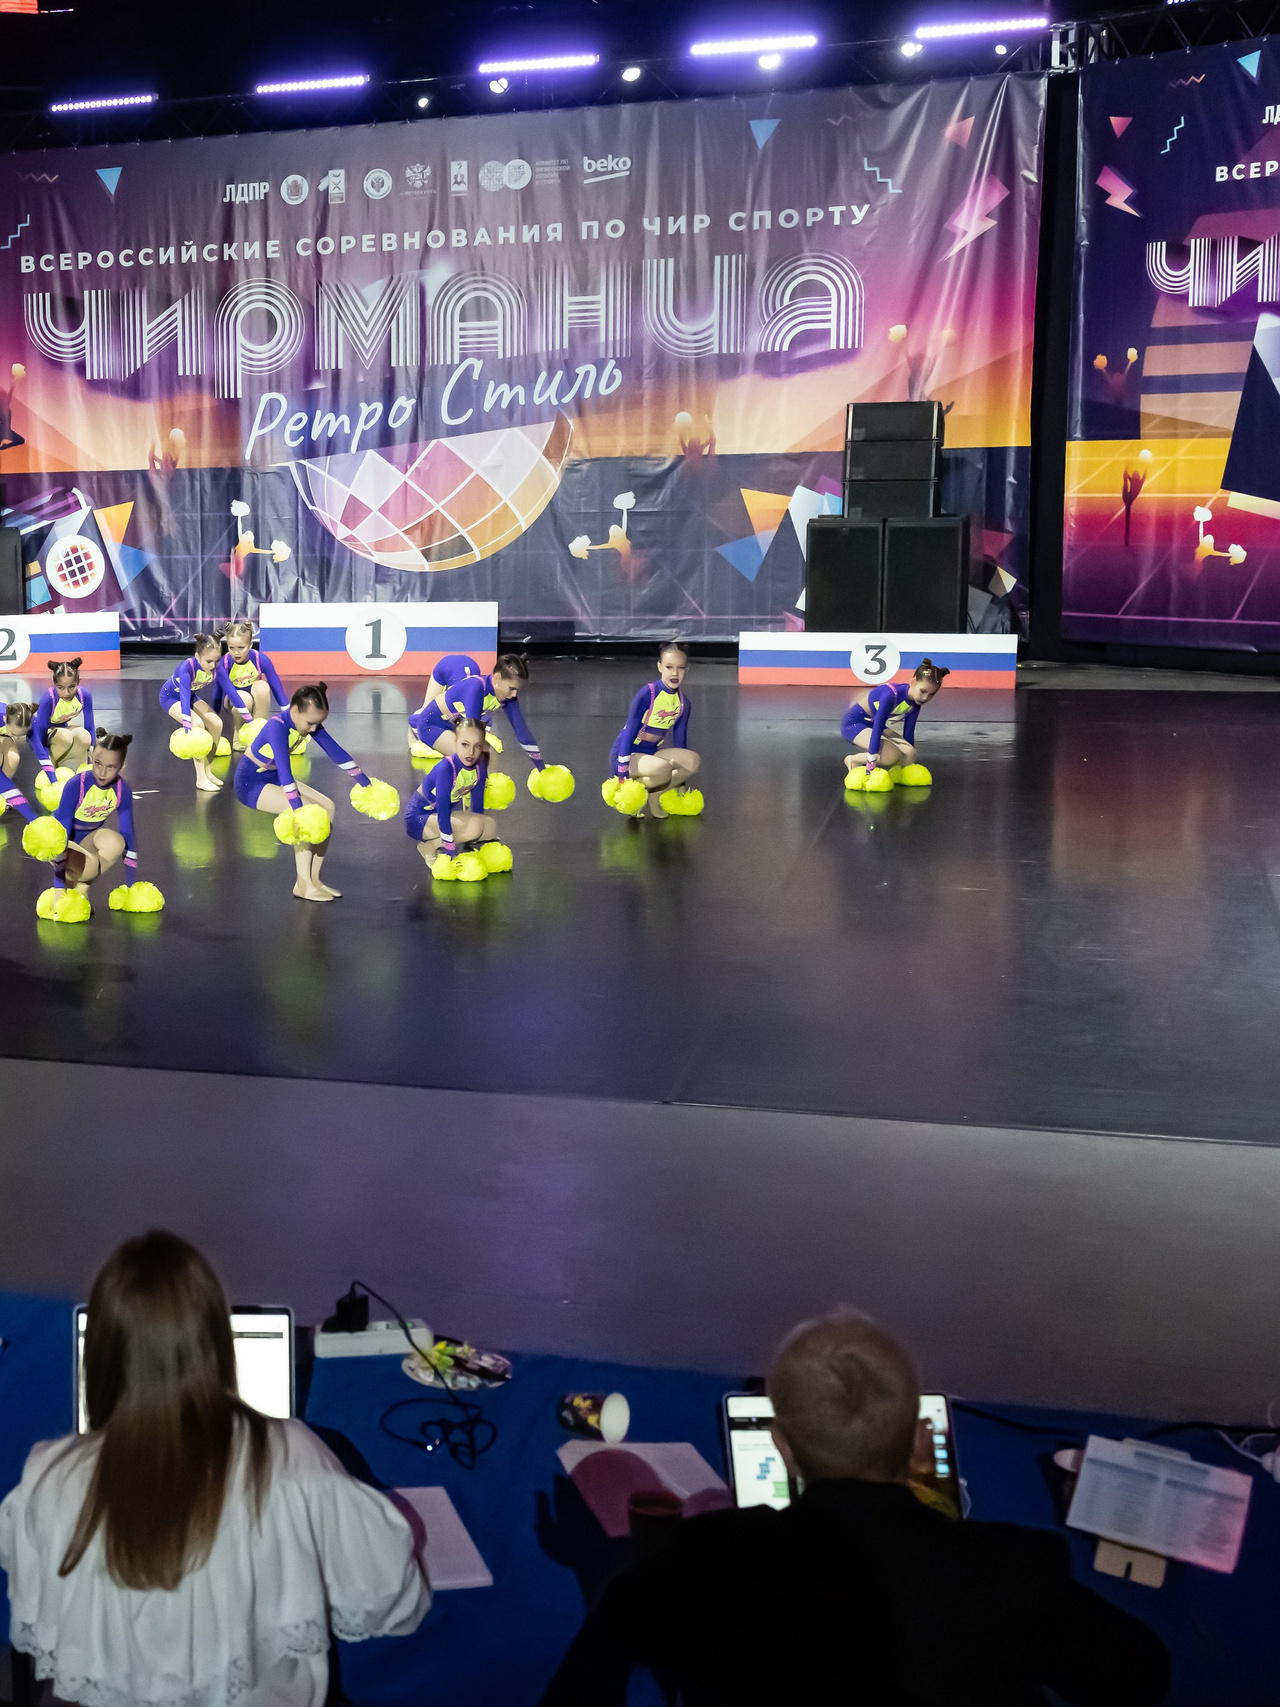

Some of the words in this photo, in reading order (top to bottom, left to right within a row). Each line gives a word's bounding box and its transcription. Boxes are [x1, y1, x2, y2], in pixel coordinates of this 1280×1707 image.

[583, 154, 632, 173] beko
[223, 182, 270, 204] ЛДПР
[20, 239, 281, 273] ВСЕРОССИЙСКИЕ
[296, 221, 564, 257] СОРЕВНОВАНИЯ
[581, 218, 627, 241] ПО
[642, 213, 712, 236] ЧИР
[728, 203, 872, 232] СПОРТУ
[245, 391, 417, 460] Ретро
[440, 357, 623, 427] Стиль
[365, 618, 387, 658] 1
[863, 644, 888, 676] 3
